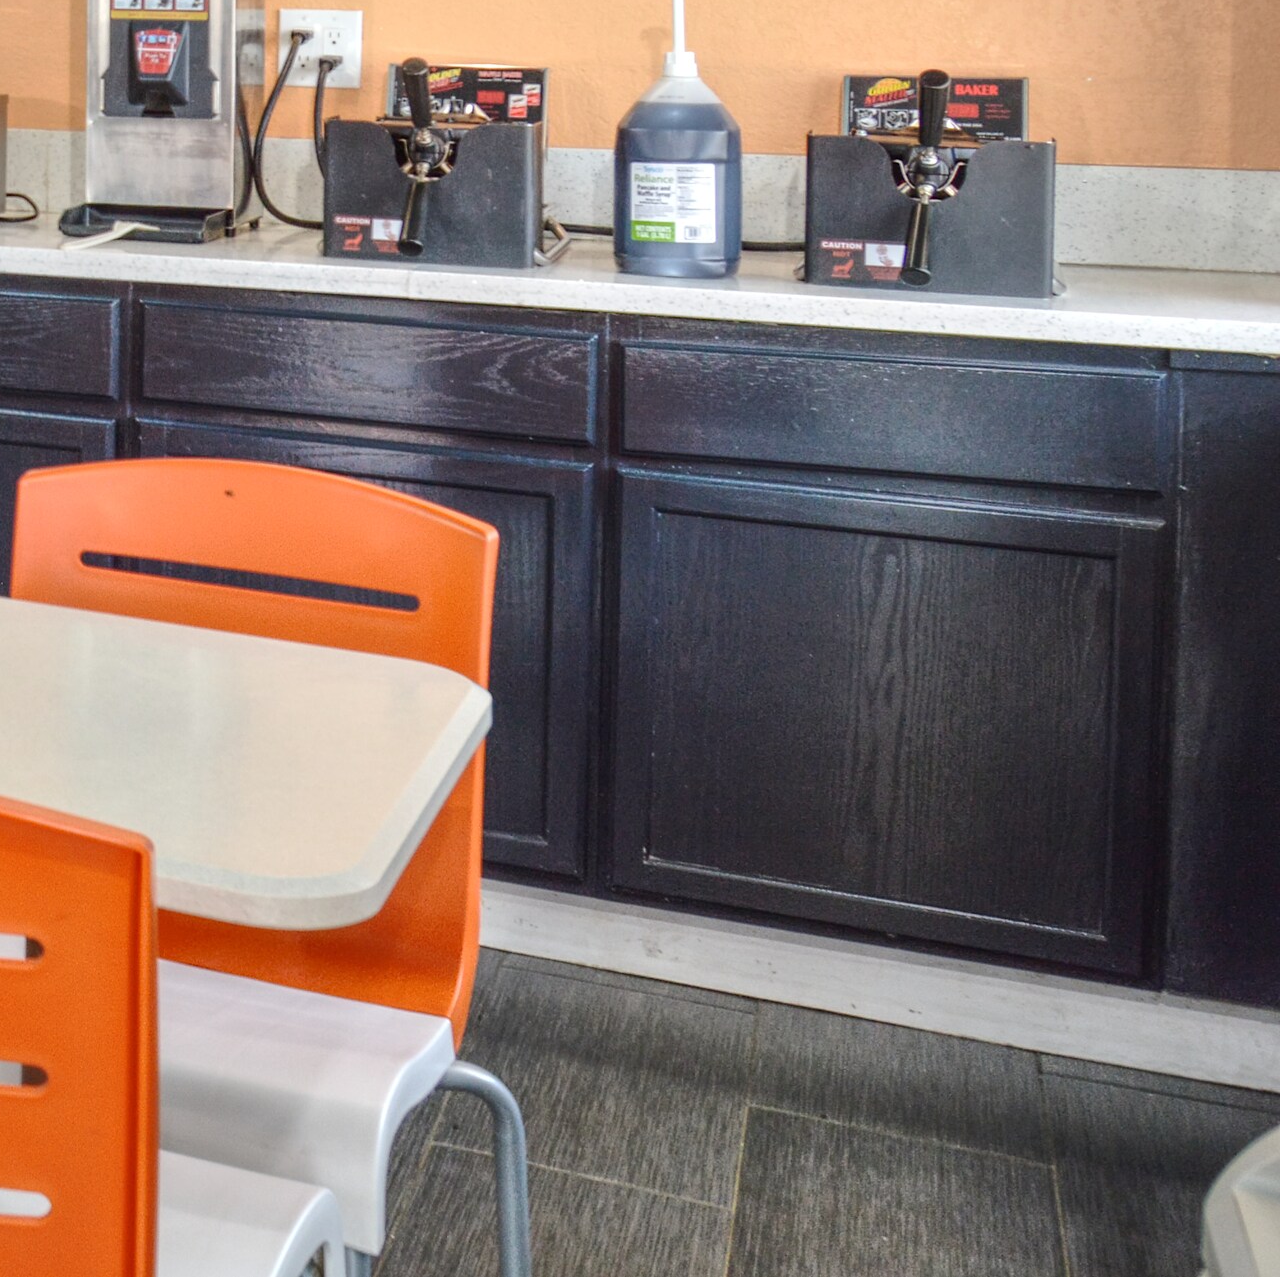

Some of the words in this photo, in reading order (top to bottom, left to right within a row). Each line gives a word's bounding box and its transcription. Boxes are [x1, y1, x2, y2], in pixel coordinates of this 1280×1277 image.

[429, 68, 461, 82] OLDEN
[954, 84, 999, 96] BAKER
[634, 174, 674, 184] Reliance
[335, 216, 370, 225] CAUTION
[821, 241, 863, 250] CAUTION
